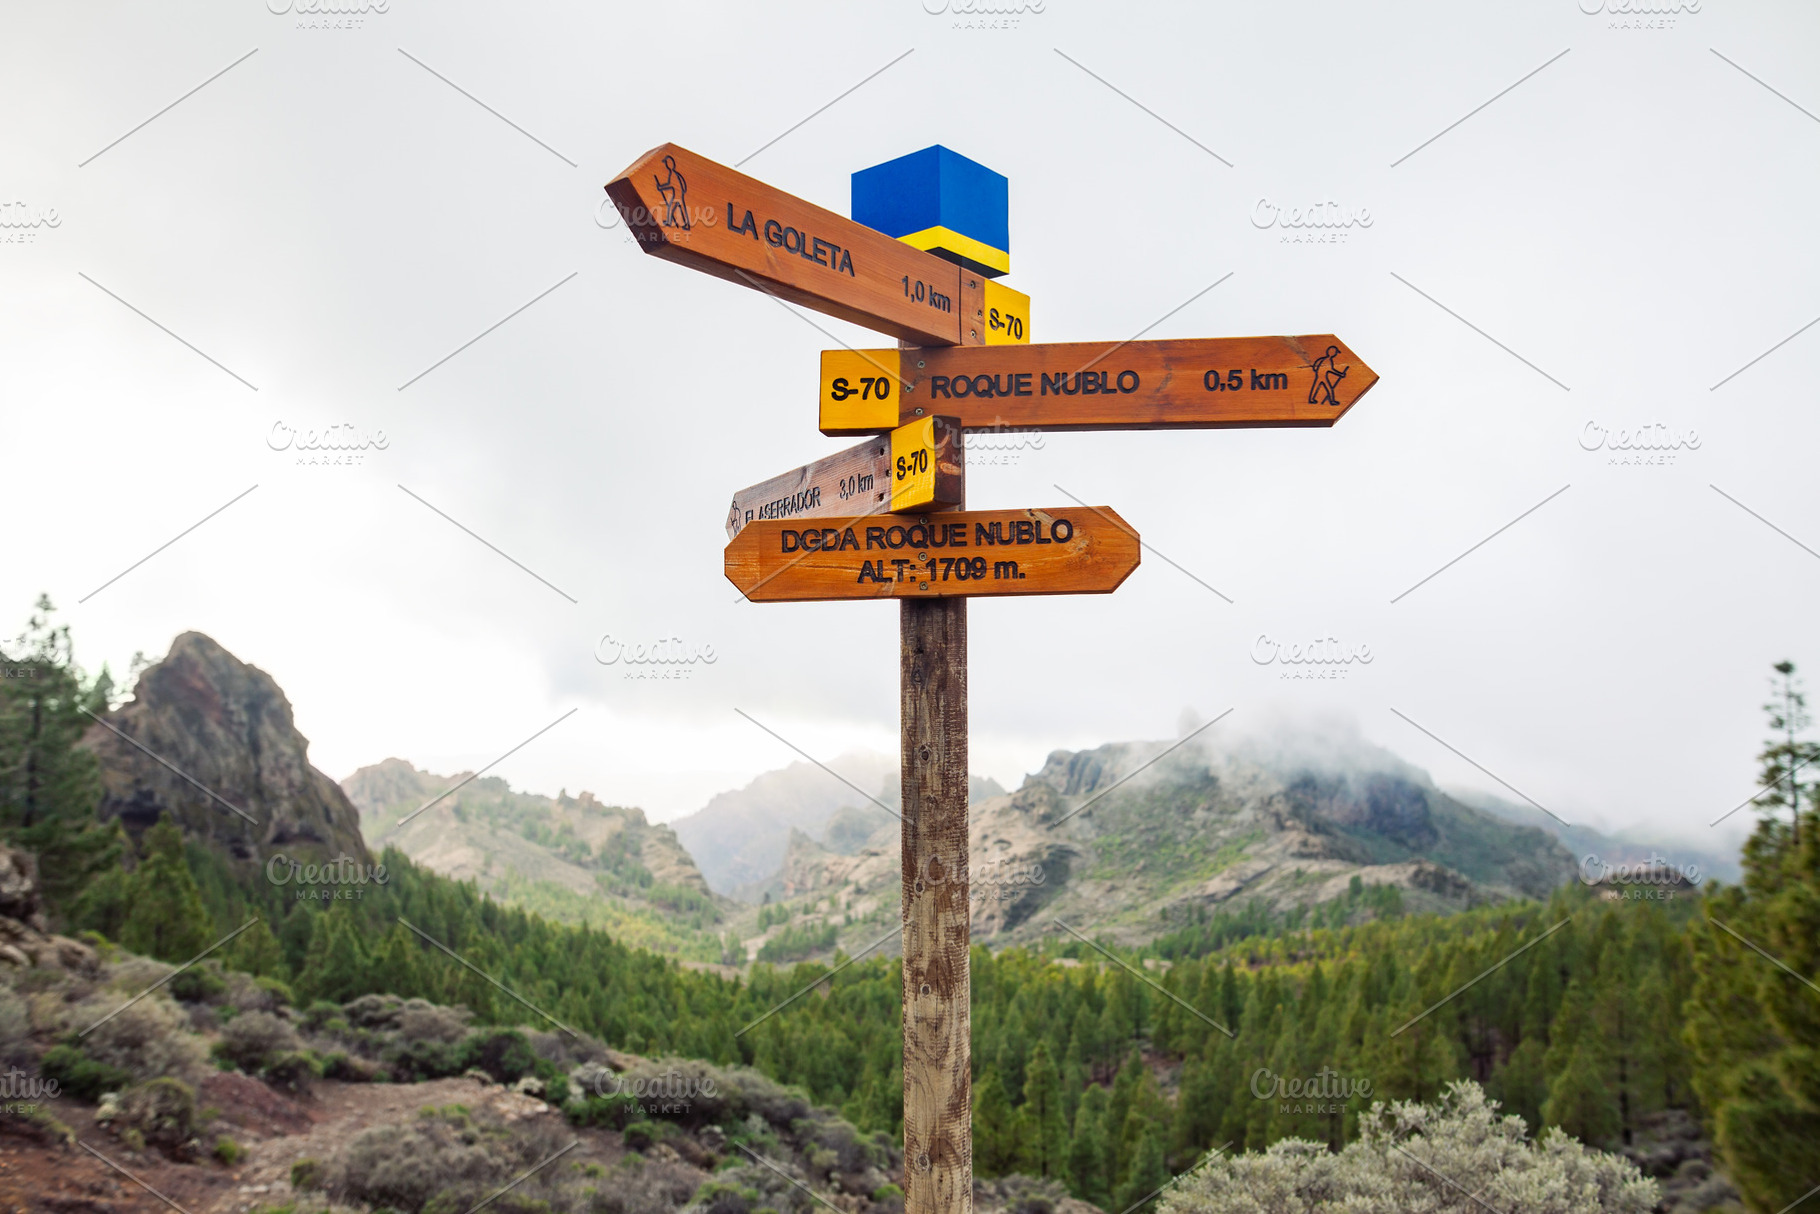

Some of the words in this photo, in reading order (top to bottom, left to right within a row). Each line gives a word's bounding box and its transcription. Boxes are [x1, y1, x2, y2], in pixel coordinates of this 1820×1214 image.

[727, 202, 759, 241] LA
[764, 219, 856, 278] GOLETA
[901, 275, 925, 304] 1,0
[929, 290, 951, 314] km
[989, 308, 1023, 341] S-70
[830, 377, 890, 401] S-70
[931, 374, 1033, 399] ROQUE
[1039, 370, 1140, 396] NUBLO
[1203, 370, 1243, 393] 0,5
[1251, 368, 1289, 391] km
[896, 448, 928, 481] S-70
[759, 486, 821, 520] ASERRADOR
[839, 475, 855, 500] 3,0
[857, 473, 874, 494] km
[782, 528, 861, 554] DGDA
[866, 523, 968, 550] ROQUE
[975, 519, 1074, 546] NUBLO
[857, 560, 916, 584] ALT:
[928, 557, 987, 582] 1709
[994, 560, 1026, 580] m.
